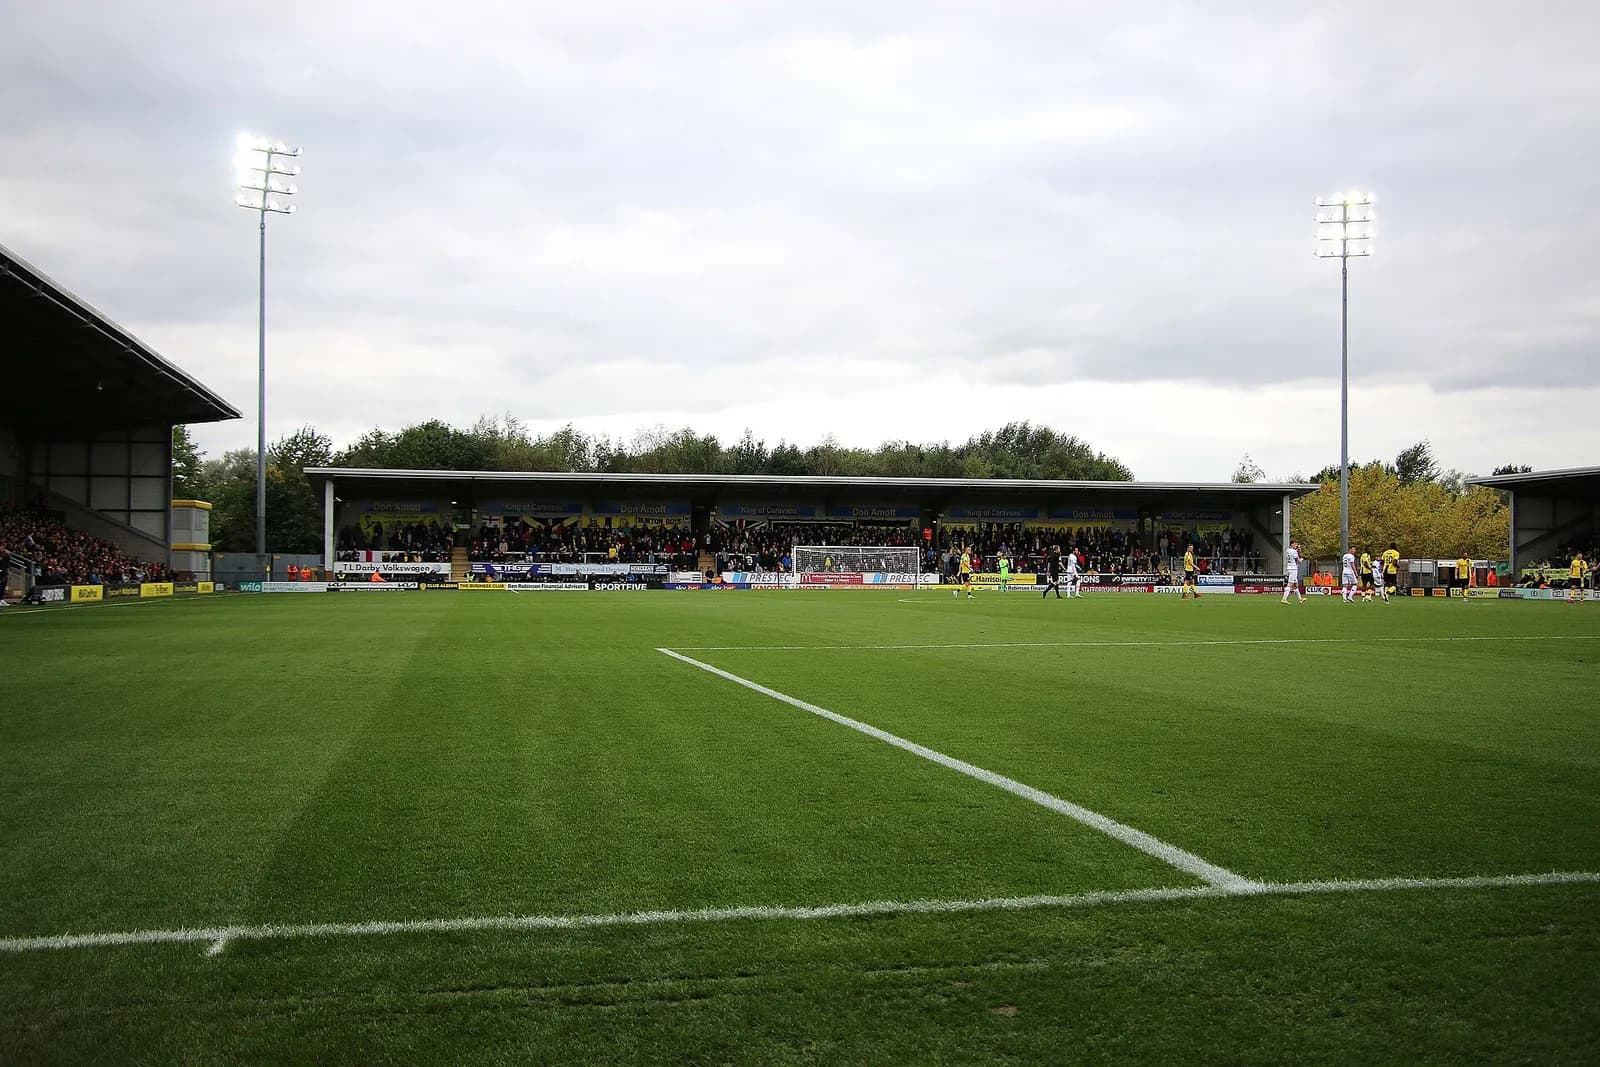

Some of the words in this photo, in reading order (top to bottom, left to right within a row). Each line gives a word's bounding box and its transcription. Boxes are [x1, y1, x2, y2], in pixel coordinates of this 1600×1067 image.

[620, 504, 638, 513] Don
[852, 507, 869, 516] Don
[1072, 511, 1090, 519] Don
[356, 564, 379, 572] Darby
[382, 564, 430, 572] Volkswagen
[749, 574, 790, 582] PRESTEC
[889, 575, 930, 583] PRESTEC
[240, 582, 261, 591] wilo
